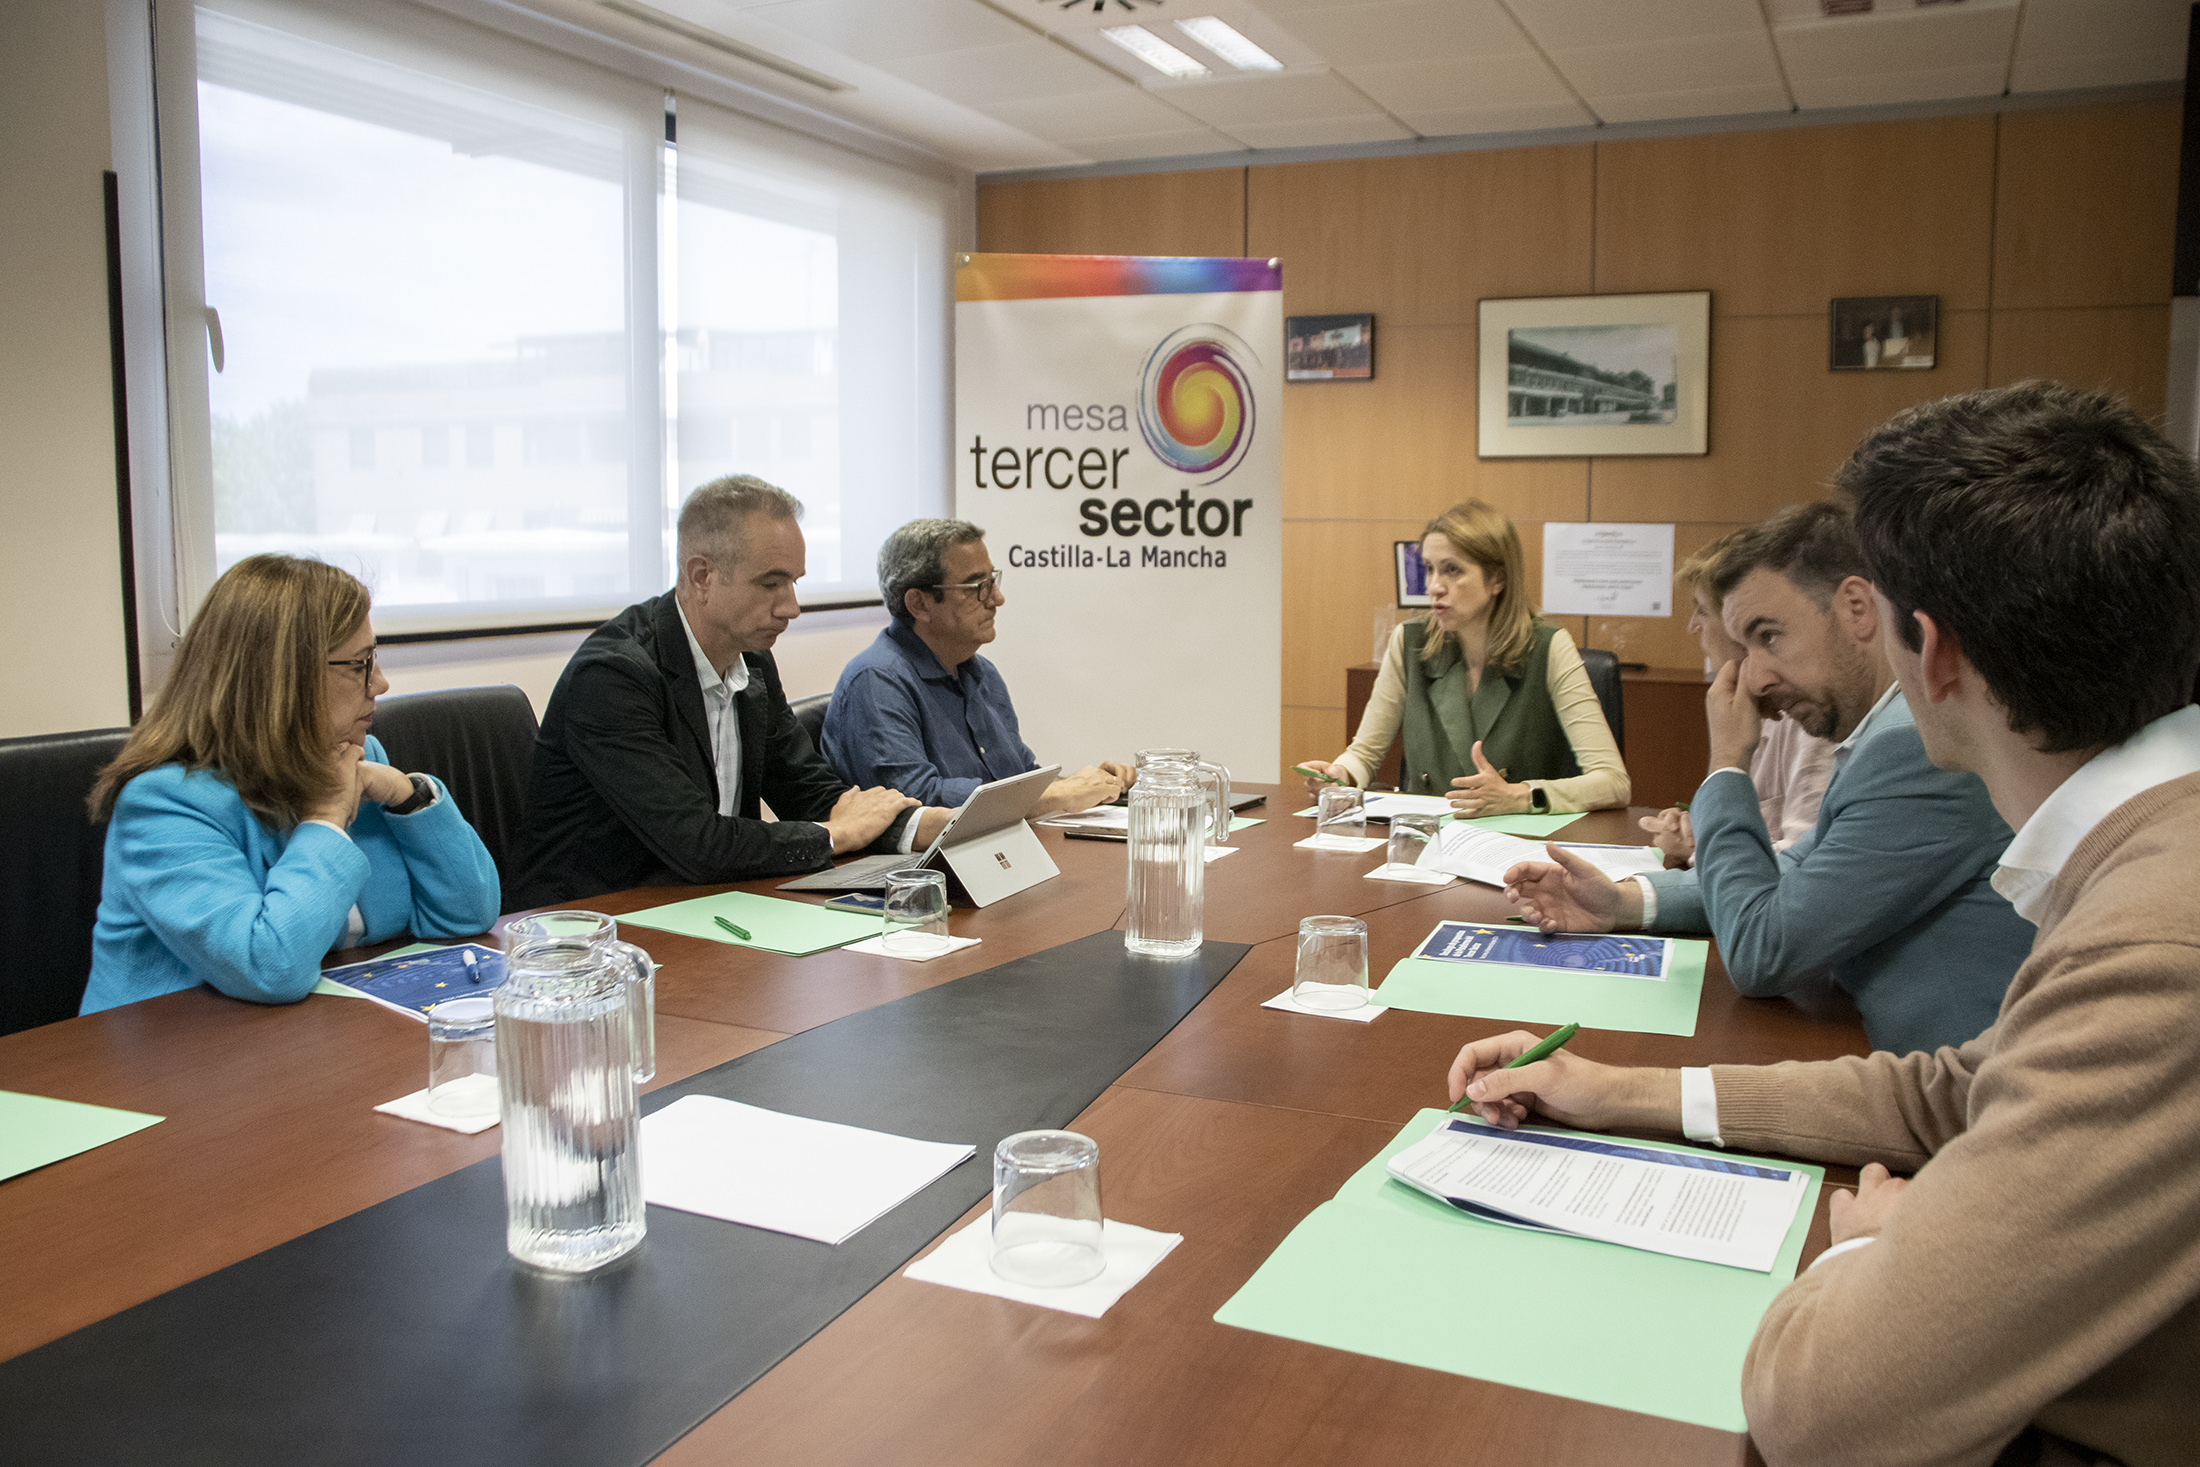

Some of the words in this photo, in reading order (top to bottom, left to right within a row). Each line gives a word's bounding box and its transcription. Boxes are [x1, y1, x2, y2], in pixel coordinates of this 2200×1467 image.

[1027, 404, 1128, 431] mesa
[970, 435, 1129, 490] tercer
[1079, 489, 1253, 537] sector
[1008, 545, 1131, 568] Castilla-La
[1142, 545, 1227, 568] Mancha
